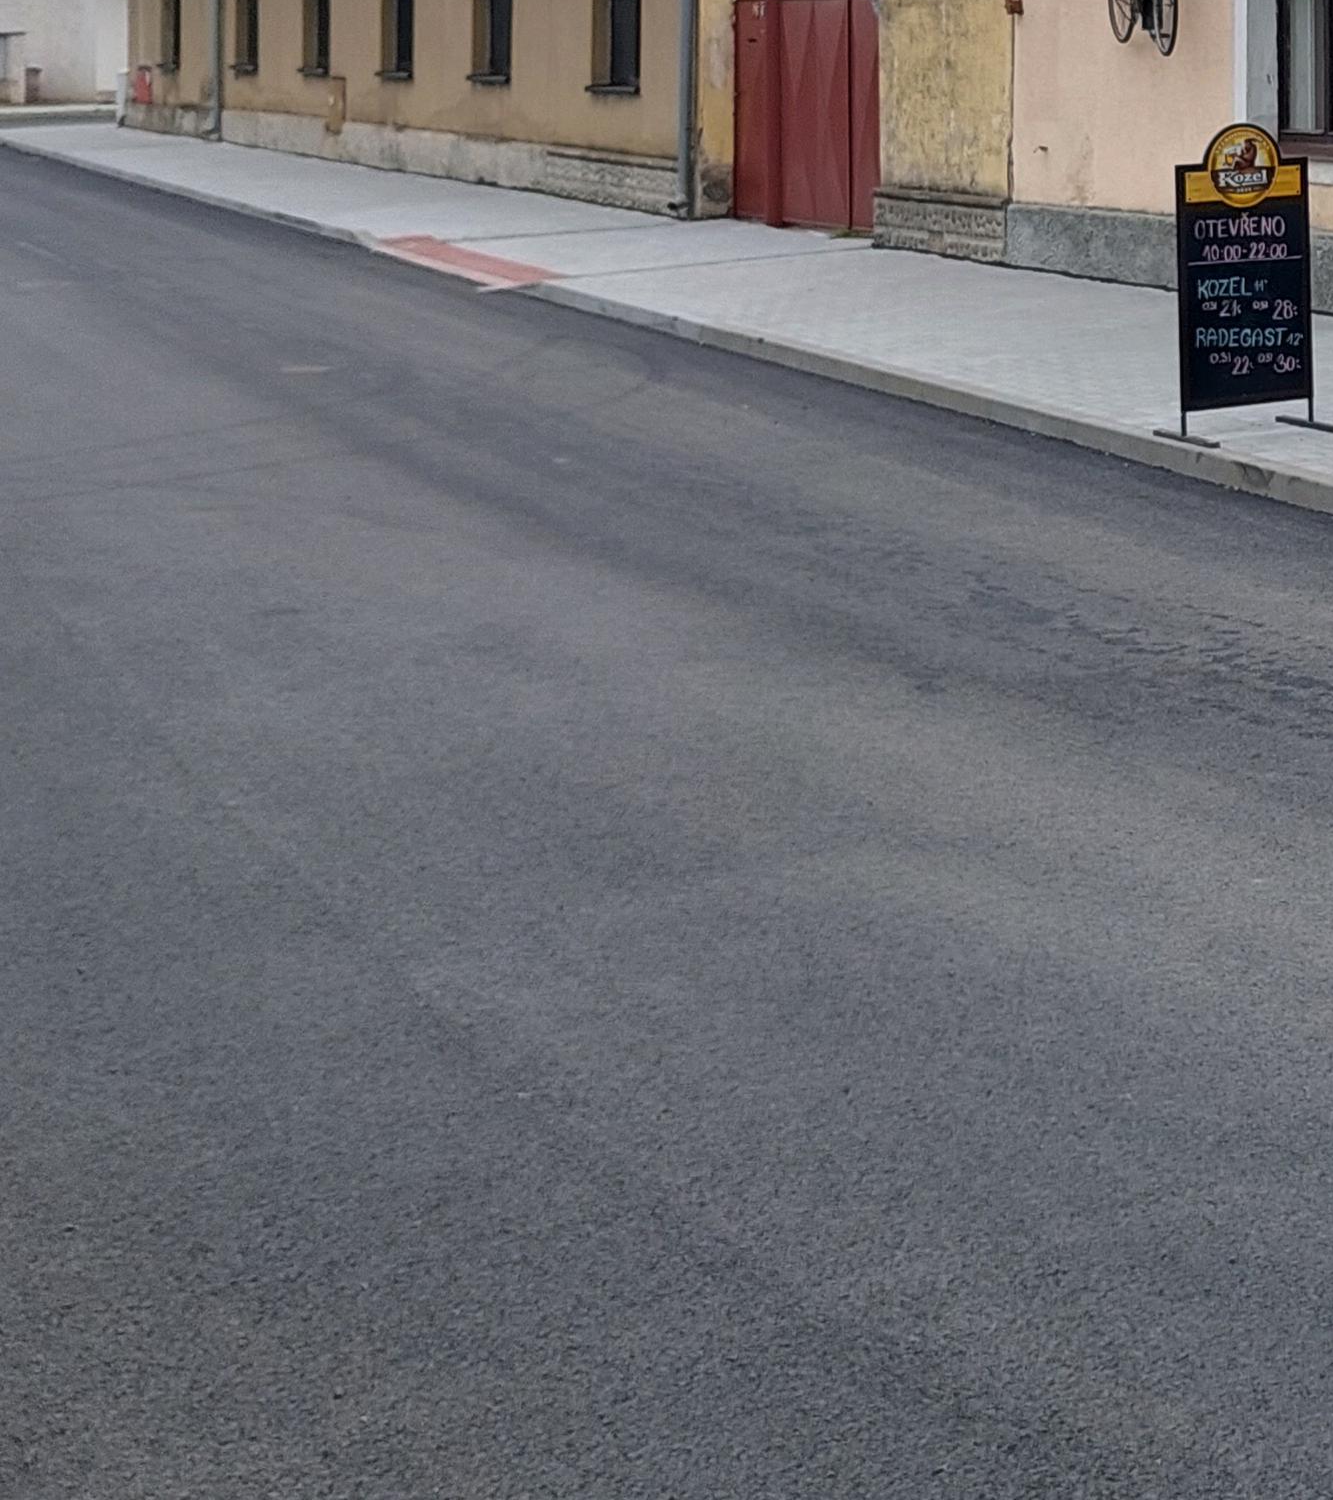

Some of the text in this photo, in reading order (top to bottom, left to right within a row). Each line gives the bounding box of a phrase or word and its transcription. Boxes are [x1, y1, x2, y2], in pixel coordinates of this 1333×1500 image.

[1218, 168, 1269, 188] Kozel
[1194, 212, 1286, 239] OTEVŘENO
[1198, 276, 1252, 299] KOZEL
[1196, 327, 1288, 348] RADEGAST
